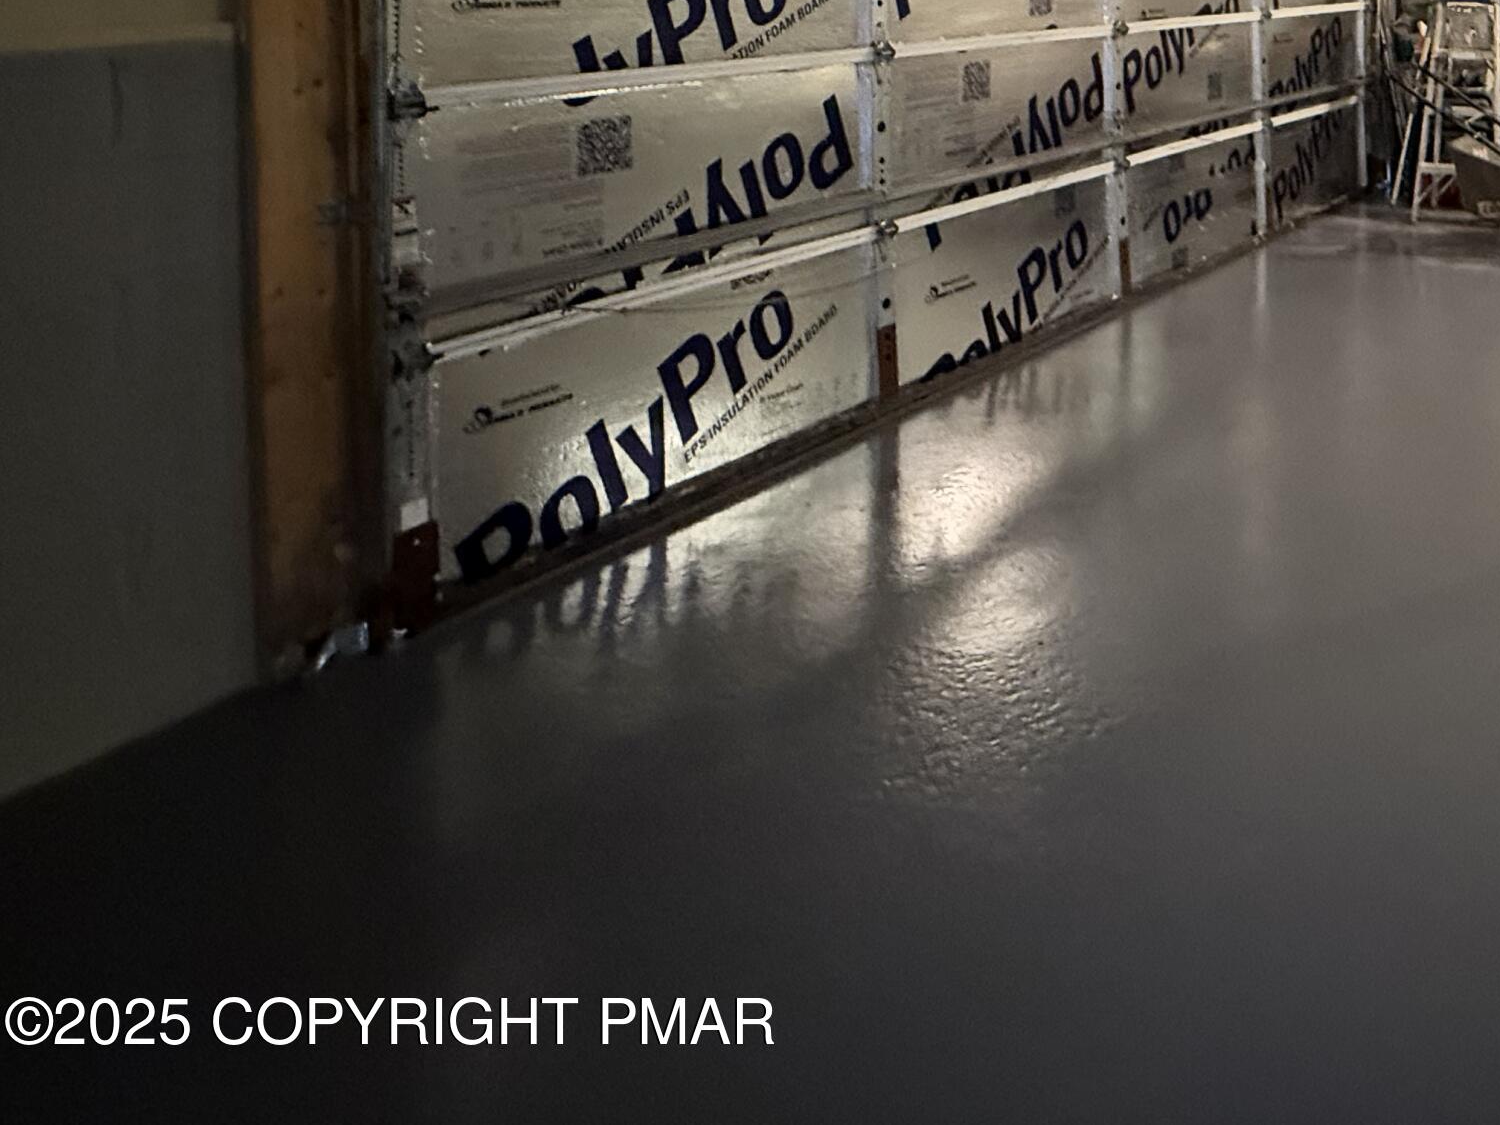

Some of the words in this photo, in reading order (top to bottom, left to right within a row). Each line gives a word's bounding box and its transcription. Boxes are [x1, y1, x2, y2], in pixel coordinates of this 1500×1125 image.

[765, 13, 796, 44] FOAM
[683, 437, 708, 464] EPS
[707, 368, 774, 440] INSULATION
[774, 339, 804, 374] FOAM
[804, 303, 838, 343] BOARD
